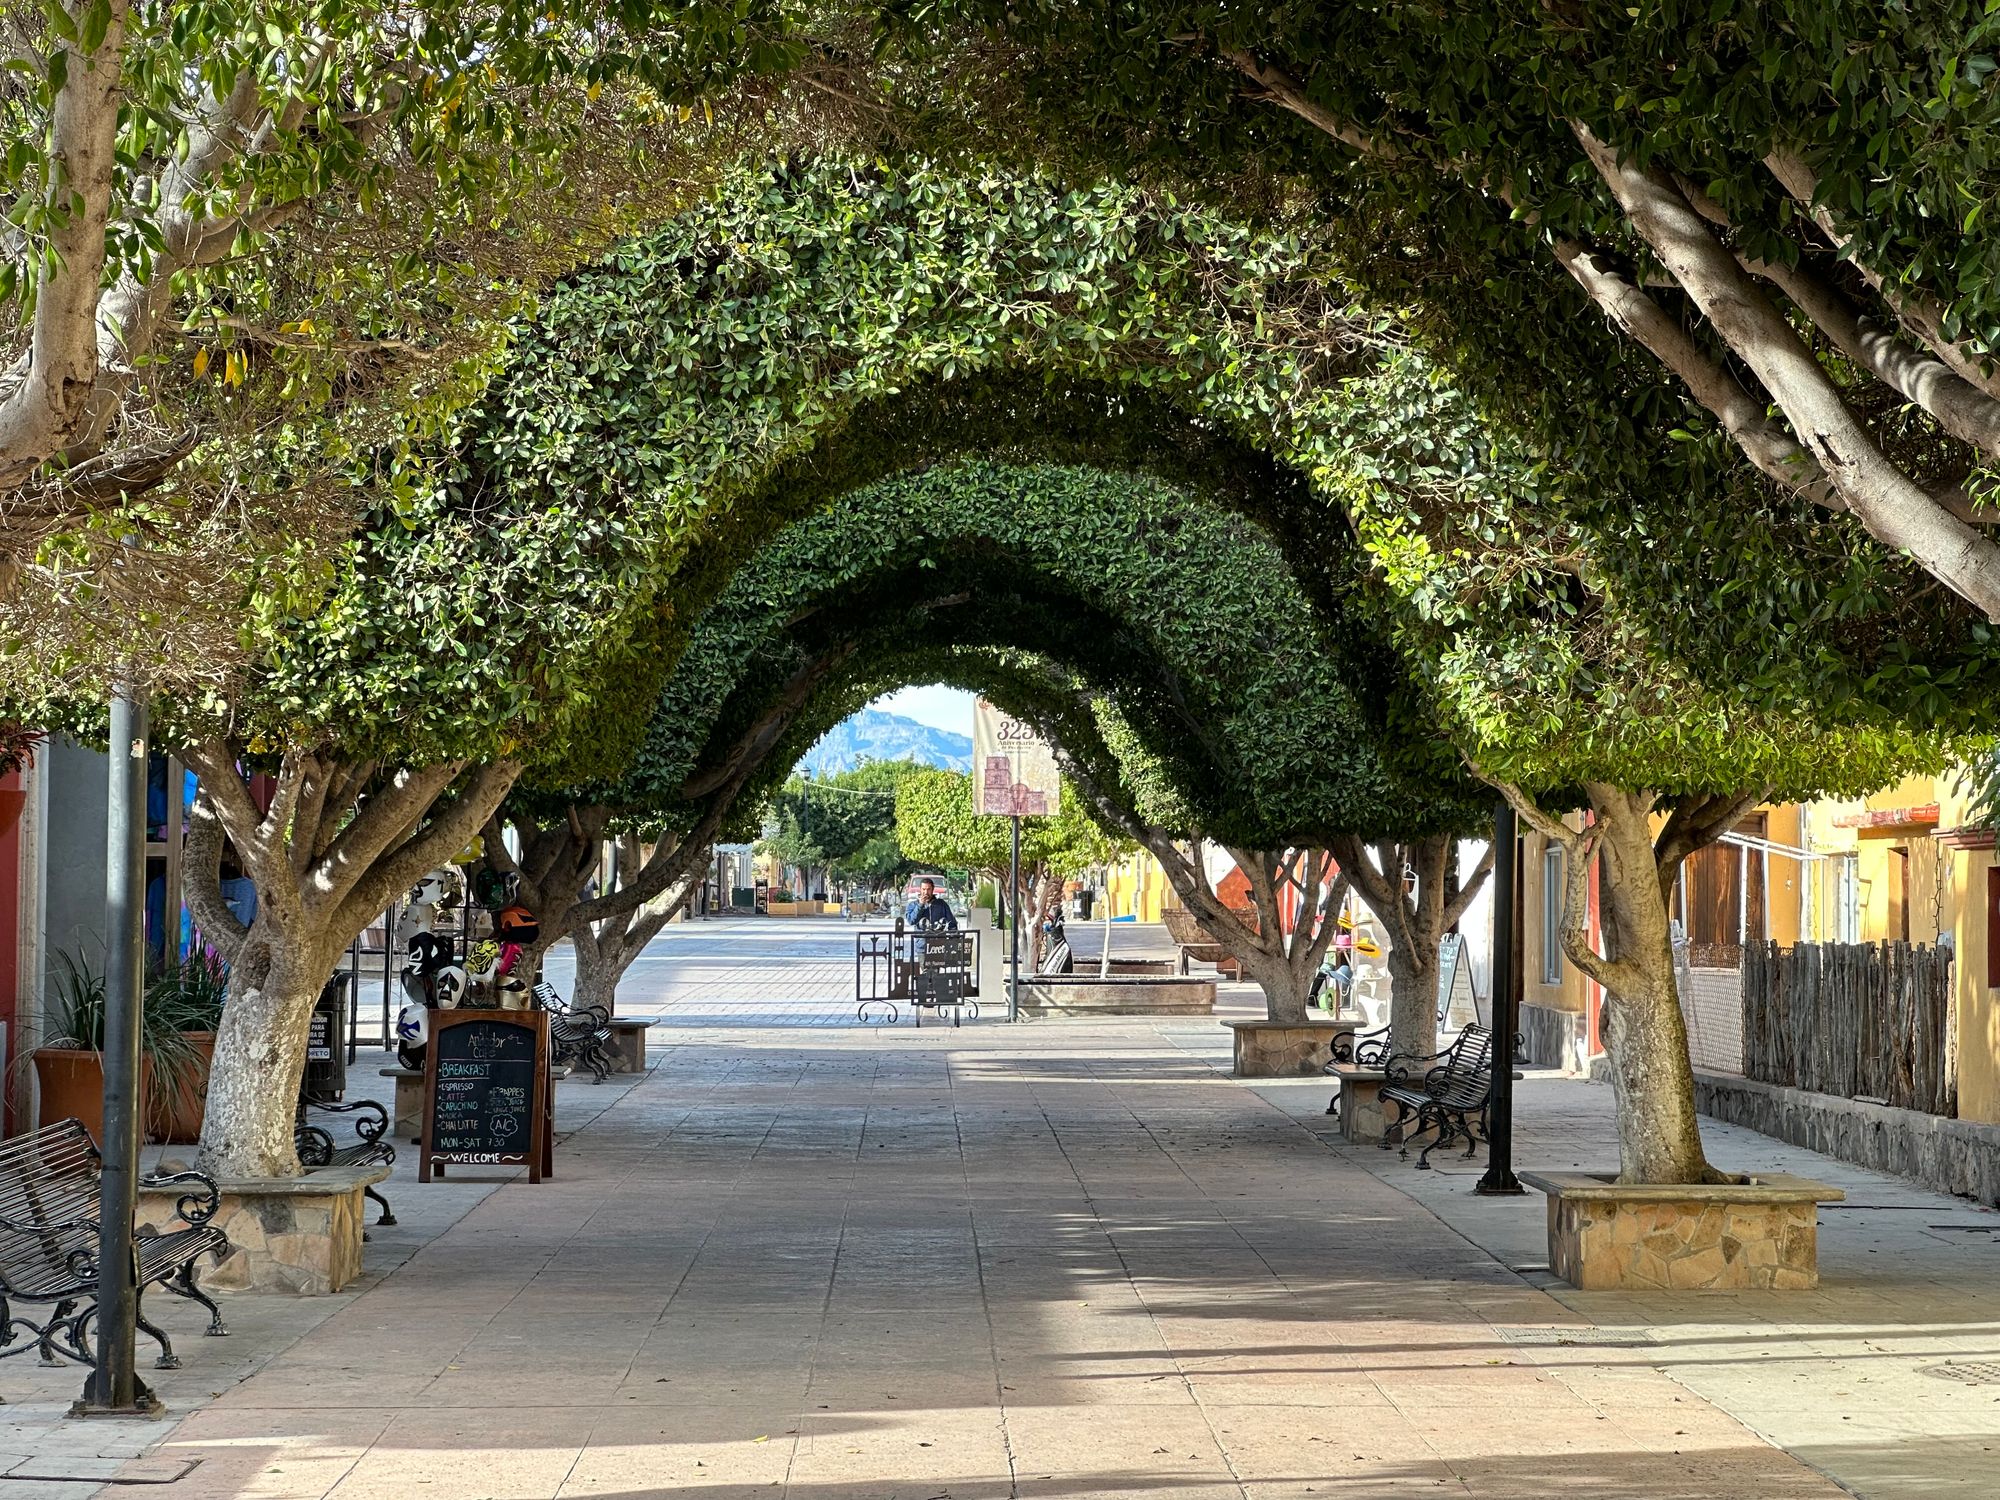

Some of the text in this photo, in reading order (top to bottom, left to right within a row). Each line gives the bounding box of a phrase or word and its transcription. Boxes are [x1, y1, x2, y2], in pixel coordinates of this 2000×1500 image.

[997, 721, 1034, 740] 325
[926, 943, 946, 954] Loret
[441, 1063, 490, 1077] BREAKFAST
[441, 1082, 474, 1091] ESPRESSO
[441, 1092, 466, 1101] LATTE
[457, 1119, 479, 1130] LATTE
[495, 1118, 512, 1132] A/C
[441, 1137, 481, 1148] MON-SAT
[450, 1152, 500, 1163] WELCOME
